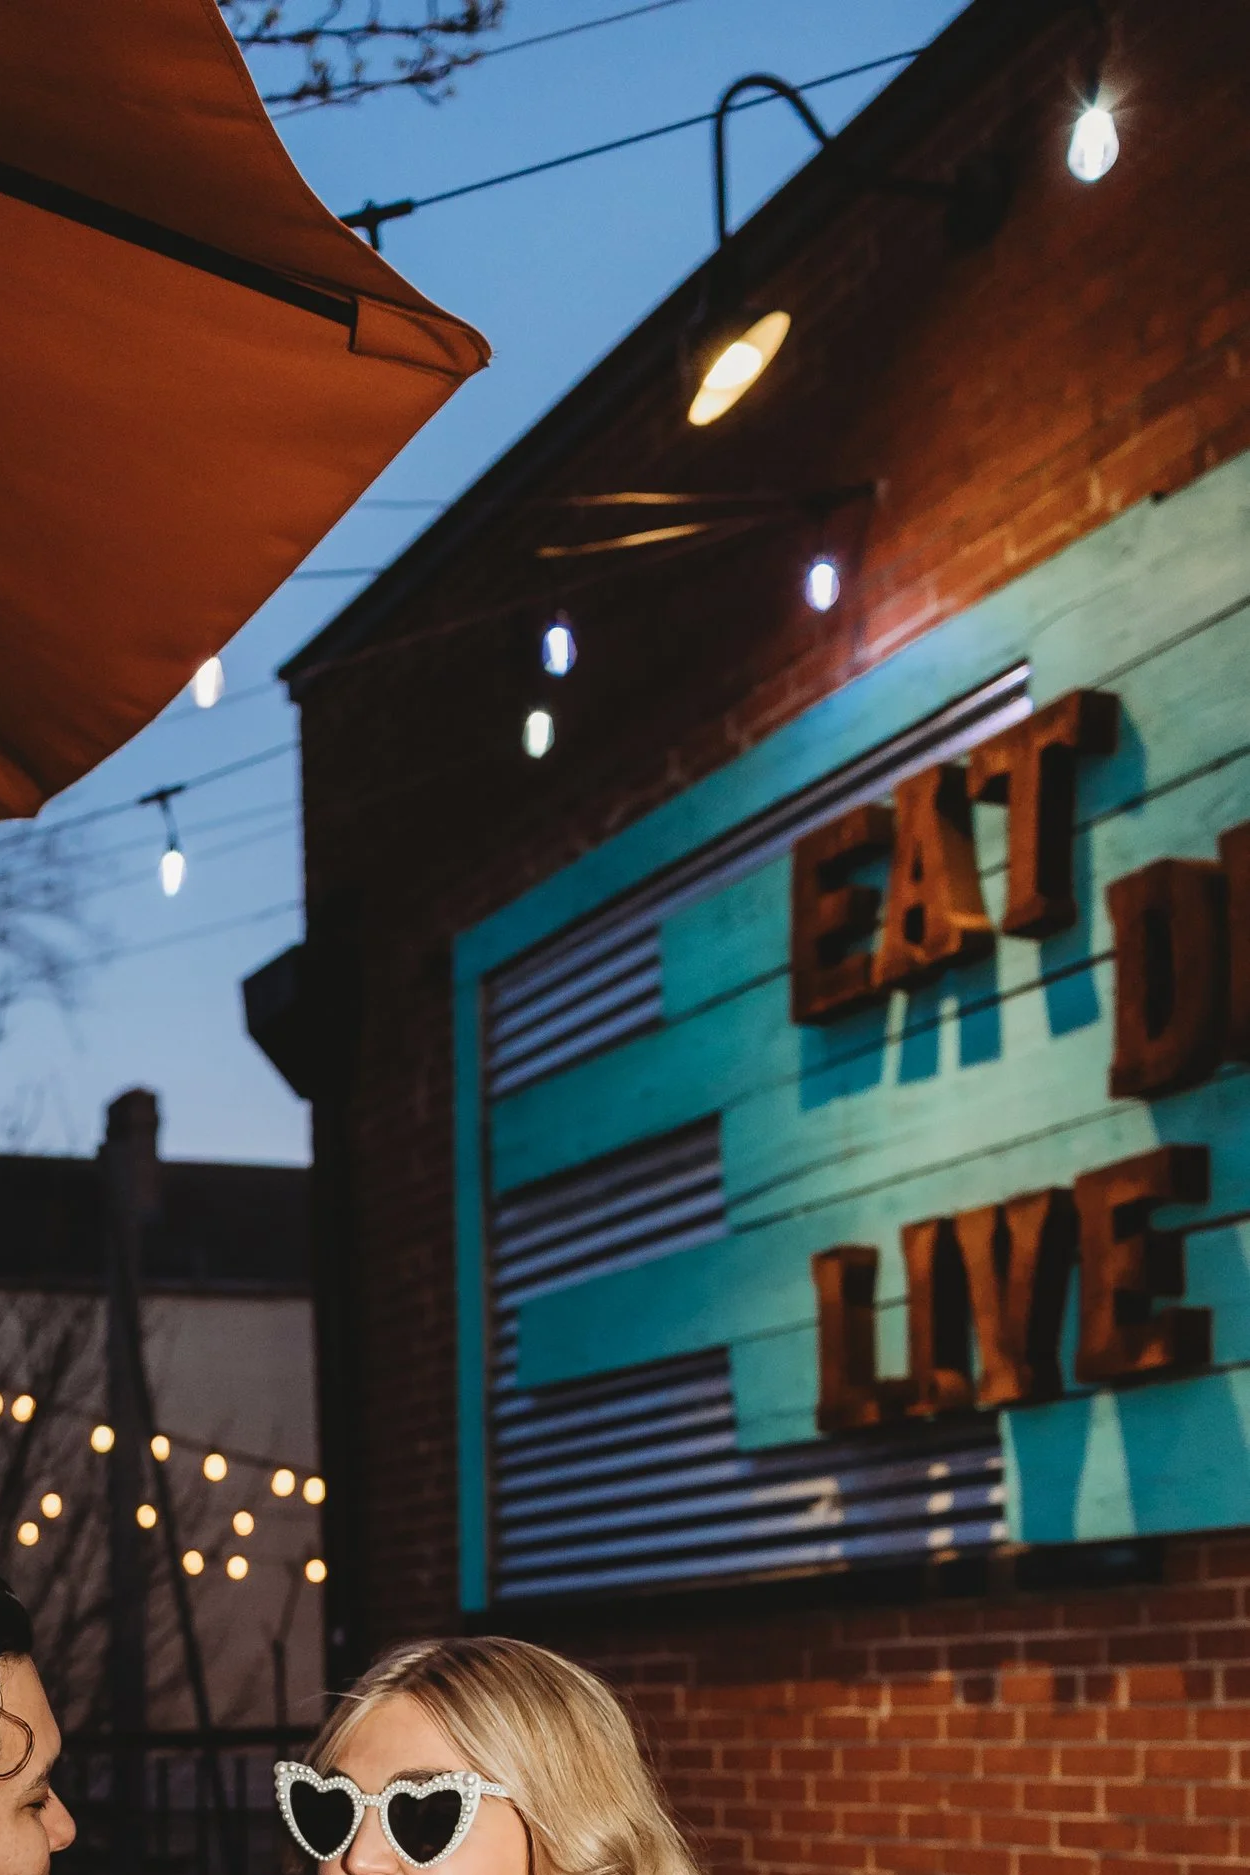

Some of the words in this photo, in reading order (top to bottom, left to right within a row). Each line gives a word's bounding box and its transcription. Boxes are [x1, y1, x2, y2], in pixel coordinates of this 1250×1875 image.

[792, 688, 1119, 1025] EAT
[1107, 820, 1250, 1099] D
[812, 1144, 1212, 1434] LIVE
